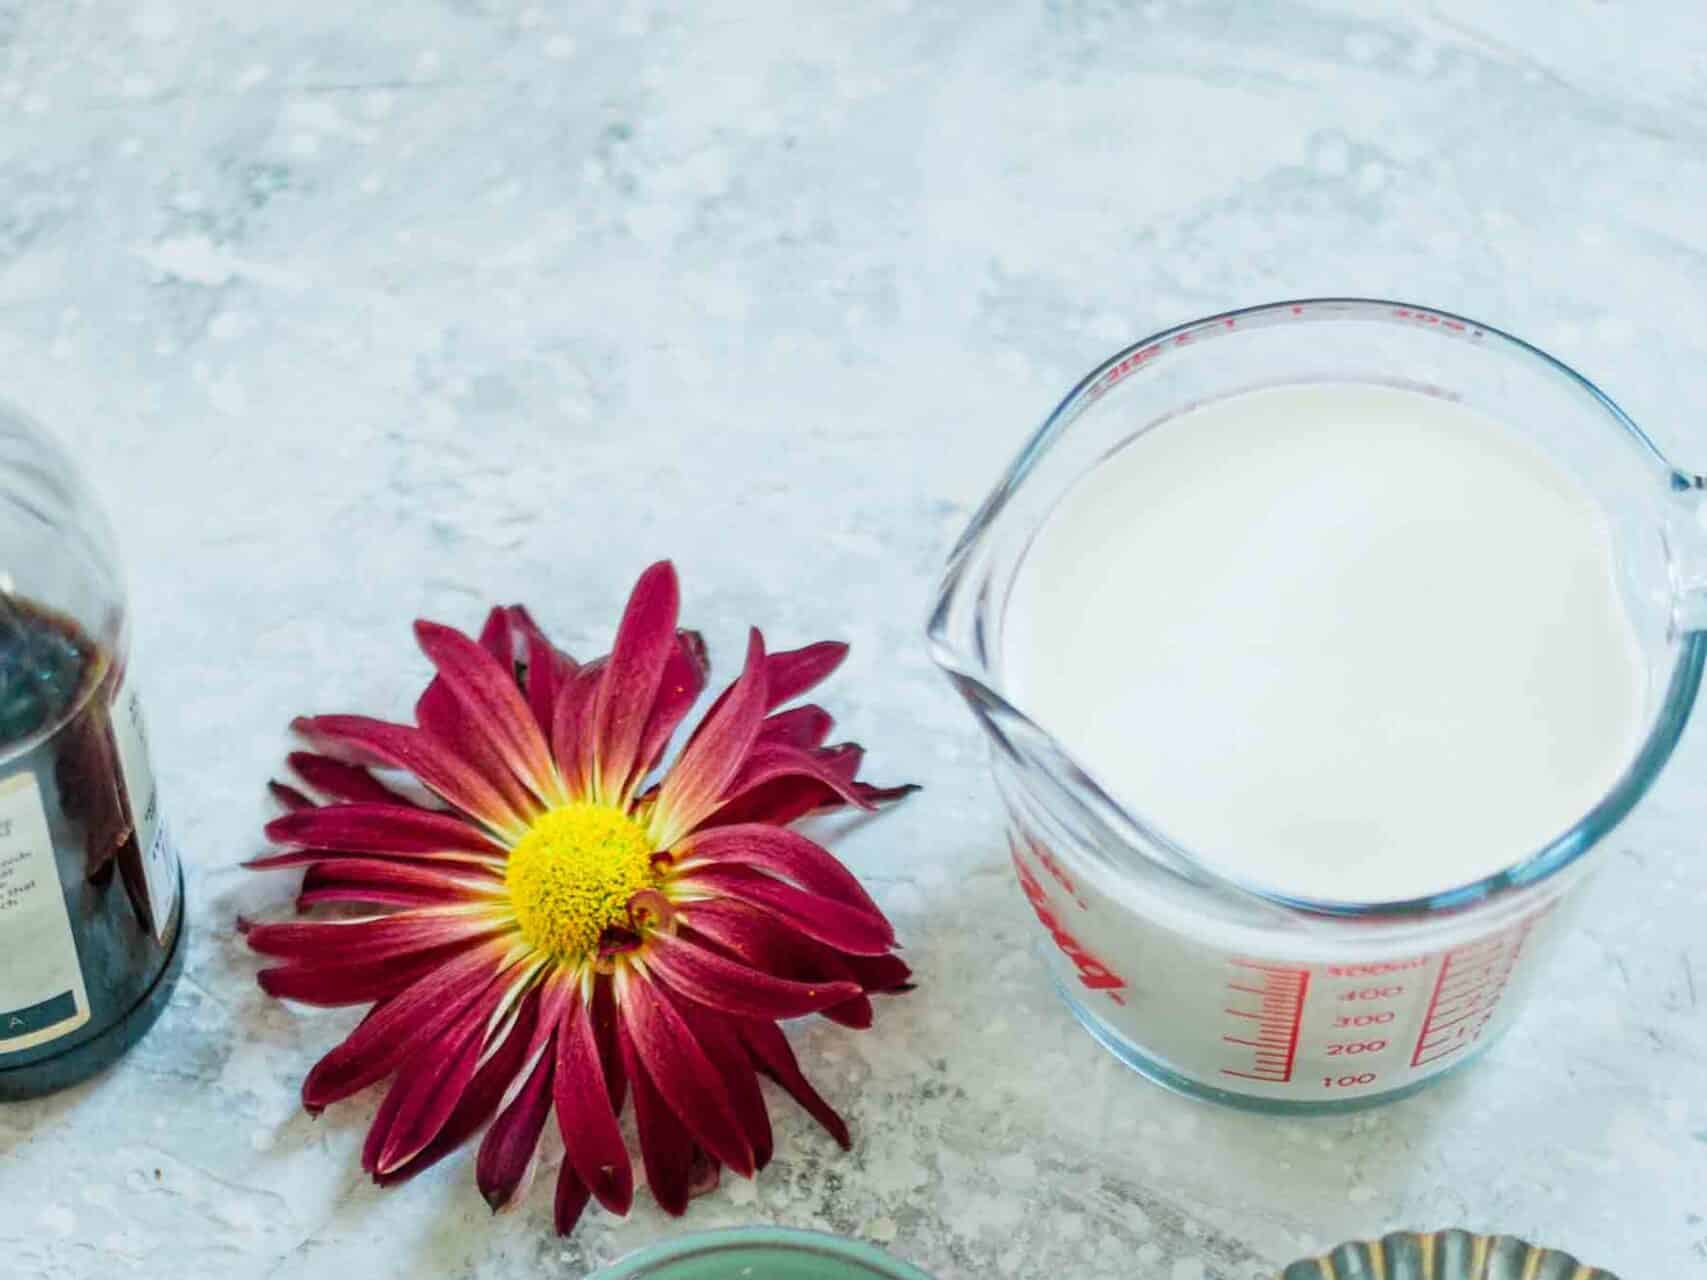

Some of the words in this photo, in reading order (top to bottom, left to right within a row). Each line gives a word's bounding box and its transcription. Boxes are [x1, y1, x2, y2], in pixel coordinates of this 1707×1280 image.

[1334, 1011, 1395, 1028] 300
[1326, 1040, 1387, 1056] 200
[1322, 1073, 1377, 1088] 100
